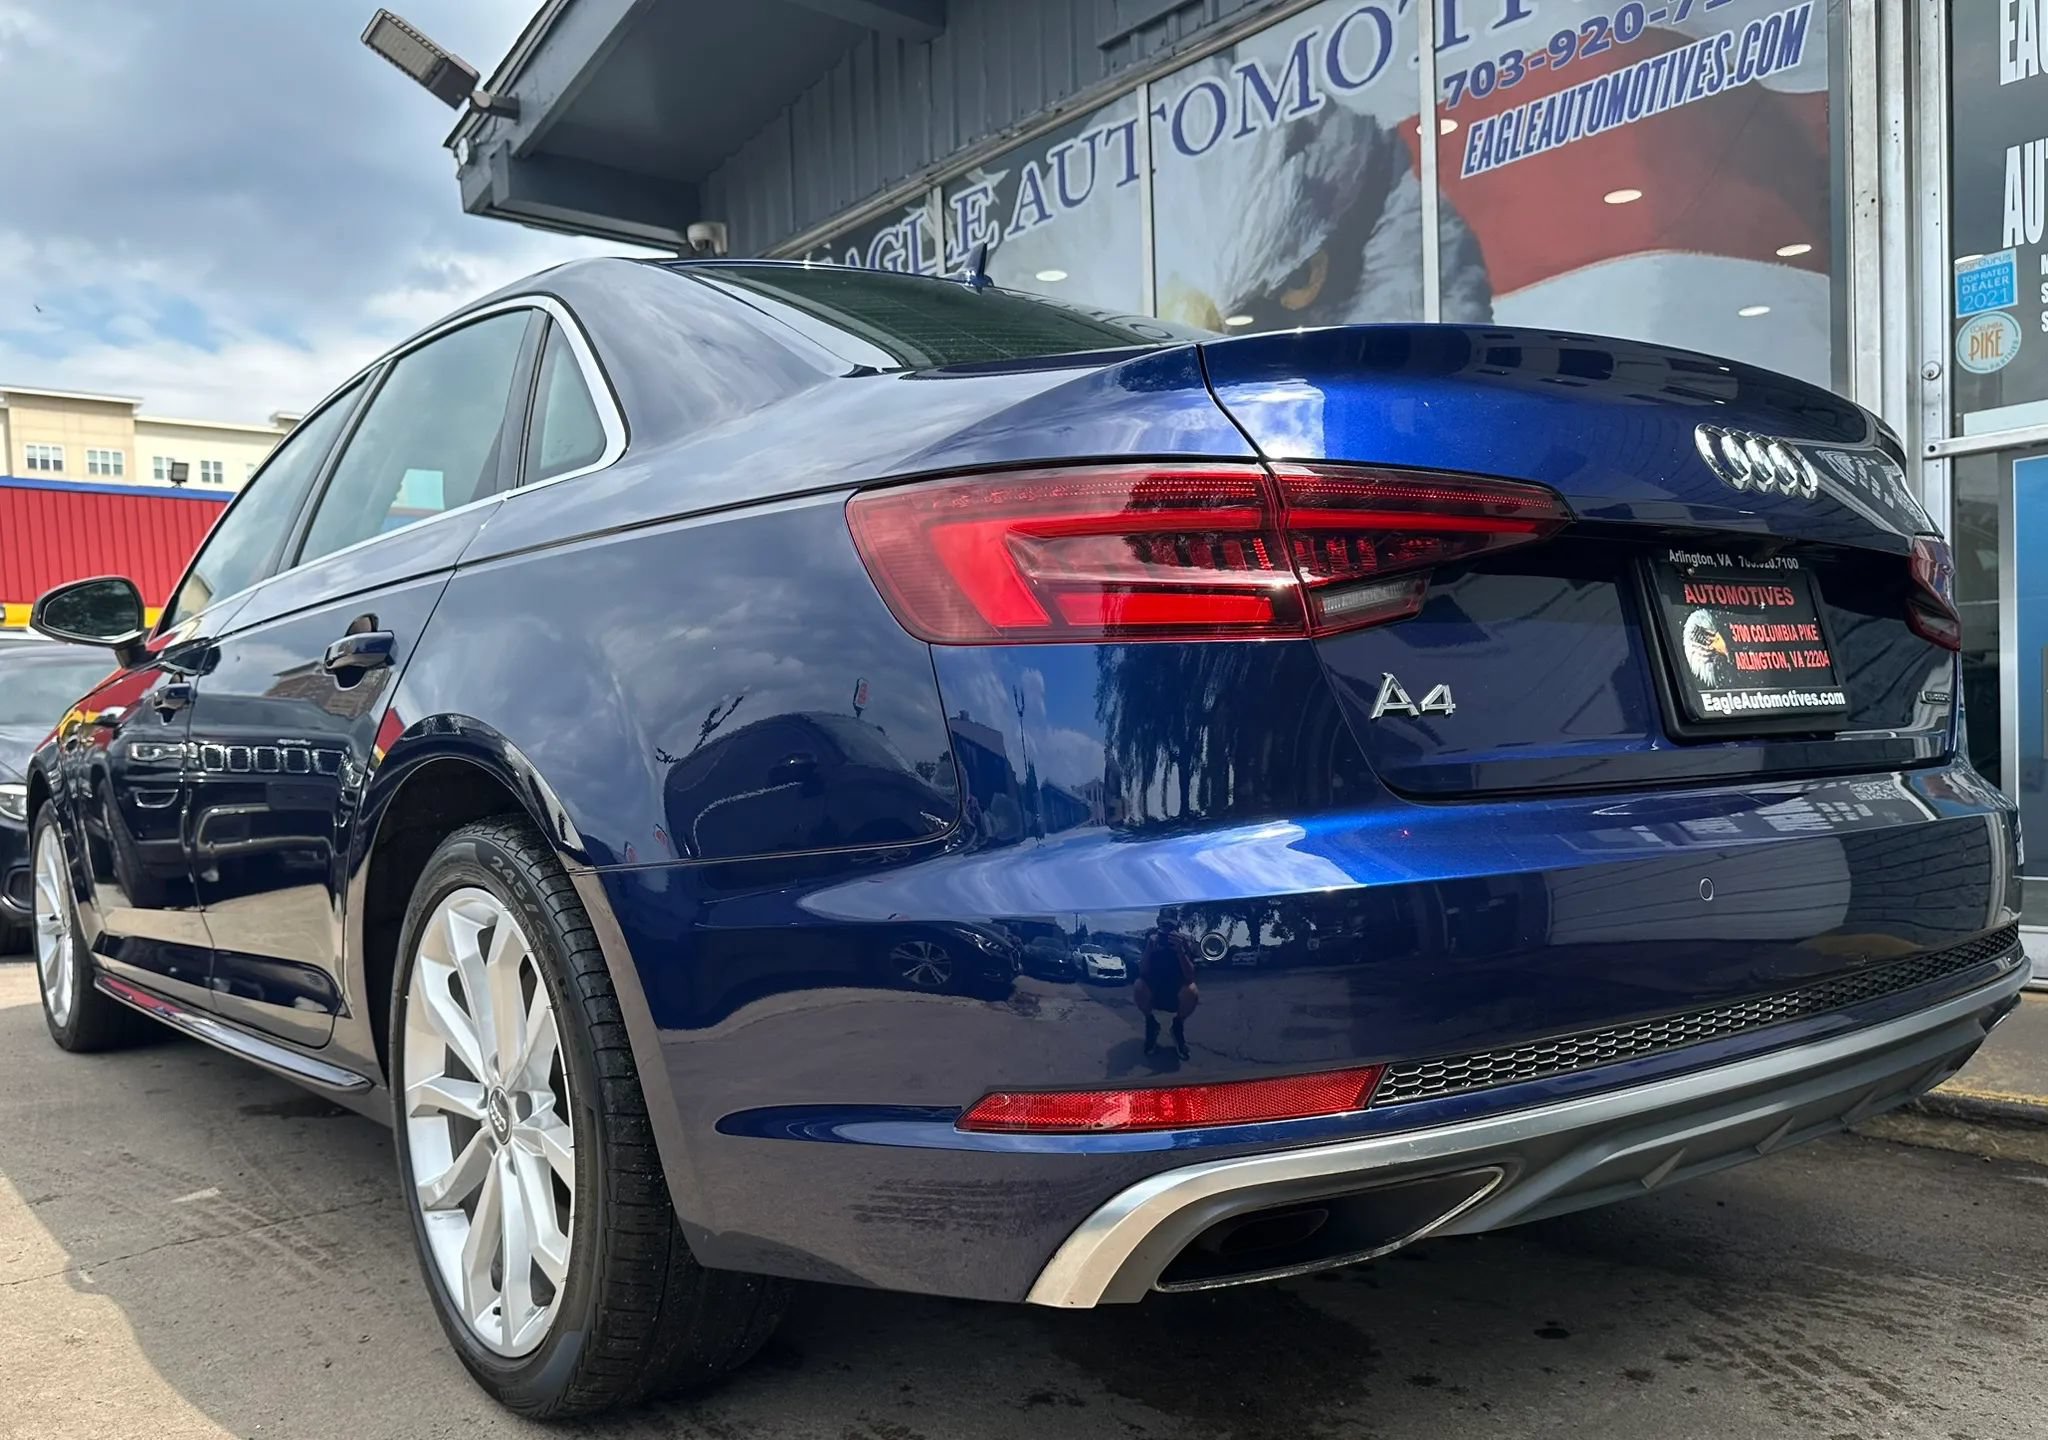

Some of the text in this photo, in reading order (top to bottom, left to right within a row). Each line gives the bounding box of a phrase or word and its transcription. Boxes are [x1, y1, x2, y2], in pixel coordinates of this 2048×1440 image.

[1461, 2, 1813, 178] EAGLEAUTOMOTIVES.COM
[1962, 266, 2009, 283] TOP RATED
[1962, 276, 2009, 294] DEALER
[1963, 288, 2009, 311] 2021
[1968, 329, 2004, 361] PIKE
[1669, 549, 1717, 567] Arlington,
[1717, 553, 1733, 567] VA
[1684, 584, 1796, 606] AUTOMOTIVES
[1731, 624, 1819, 642] 3700 COLUMBIA PIKE
[1735, 650, 1830, 672] ARLINGTON, VA 22204
[1370, 672, 1456, 719] A4
[1701, 690, 1846, 715] EagleAutomotives.com
